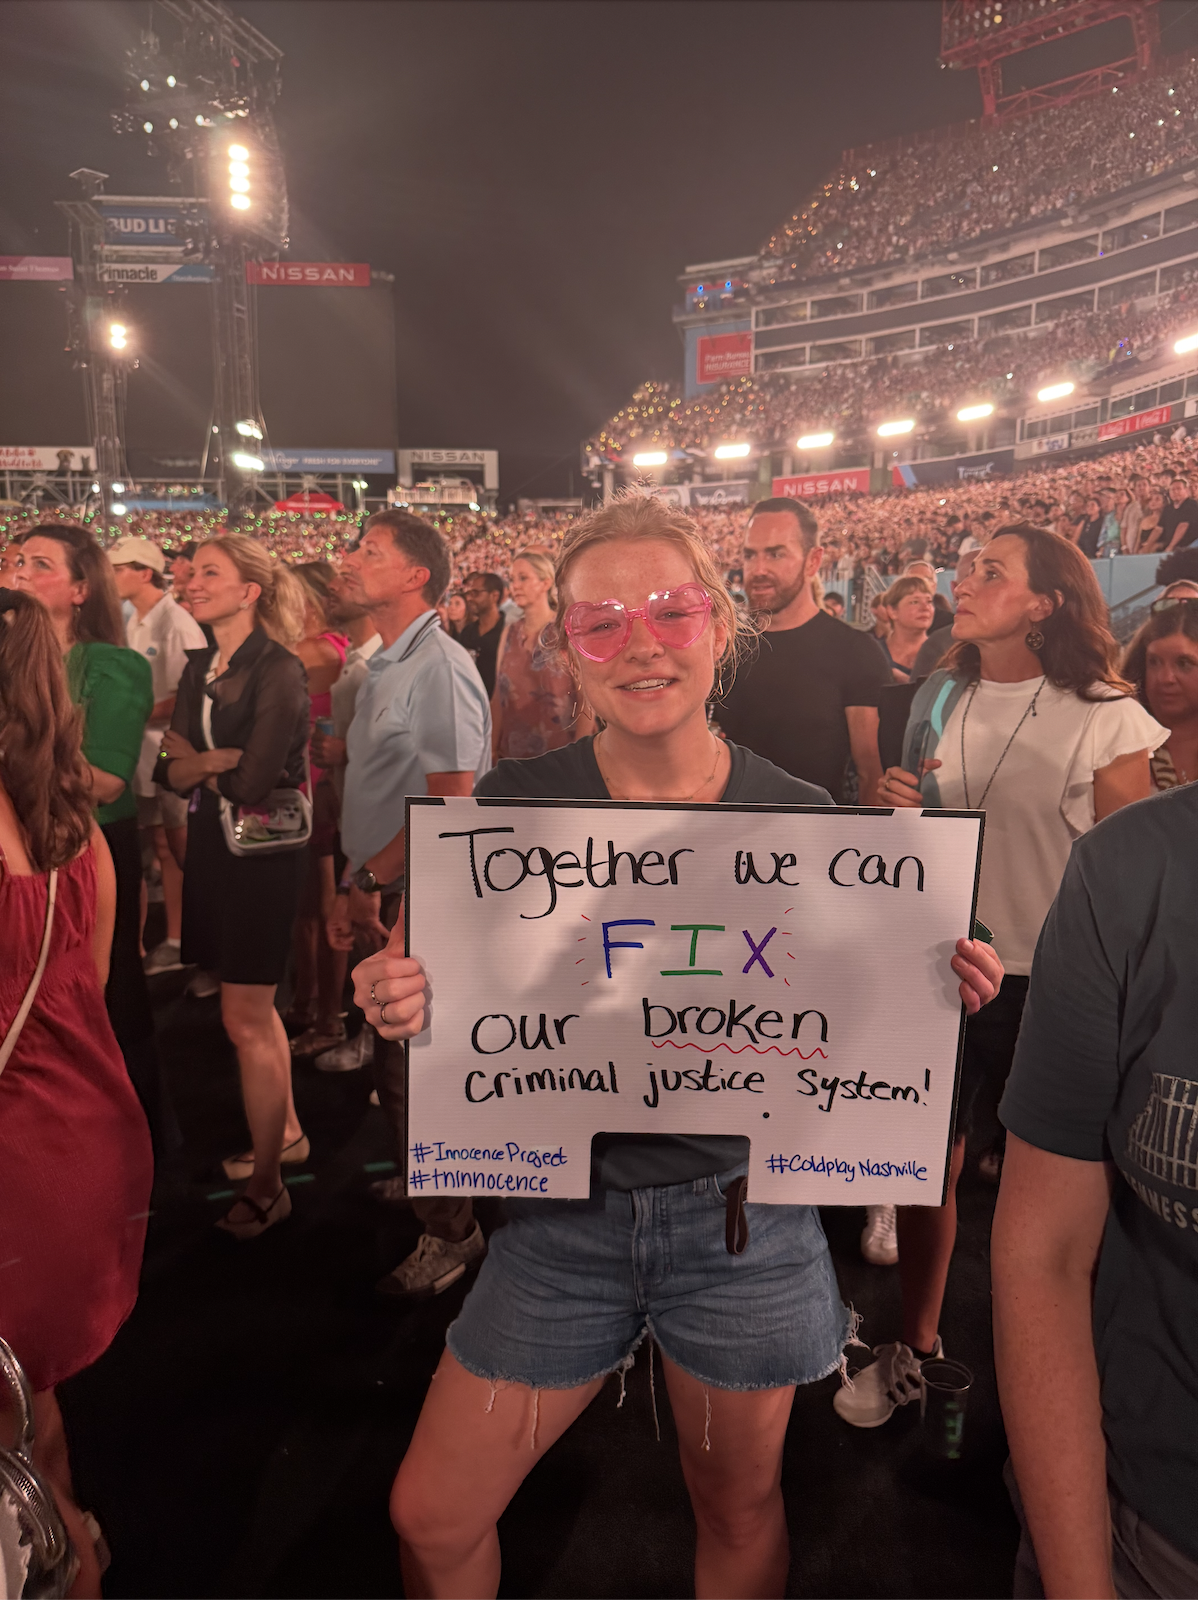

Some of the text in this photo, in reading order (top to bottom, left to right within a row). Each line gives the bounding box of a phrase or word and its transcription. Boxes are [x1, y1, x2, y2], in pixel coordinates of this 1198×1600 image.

[99, 266, 158, 281] innacle
[261, 267, 355, 282] NISSAN
[411, 451, 485, 462] NISSAN
[783, 478, 858, 497] NISSAN
[439, 827, 925, 919] Together we can
[602, 919, 778, 978] FIX
[470, 997, 829, 1055] our broken
[465, 1058, 931, 1112] criminal justice system!
[1122, 1170, 1198, 1233] ENNES
